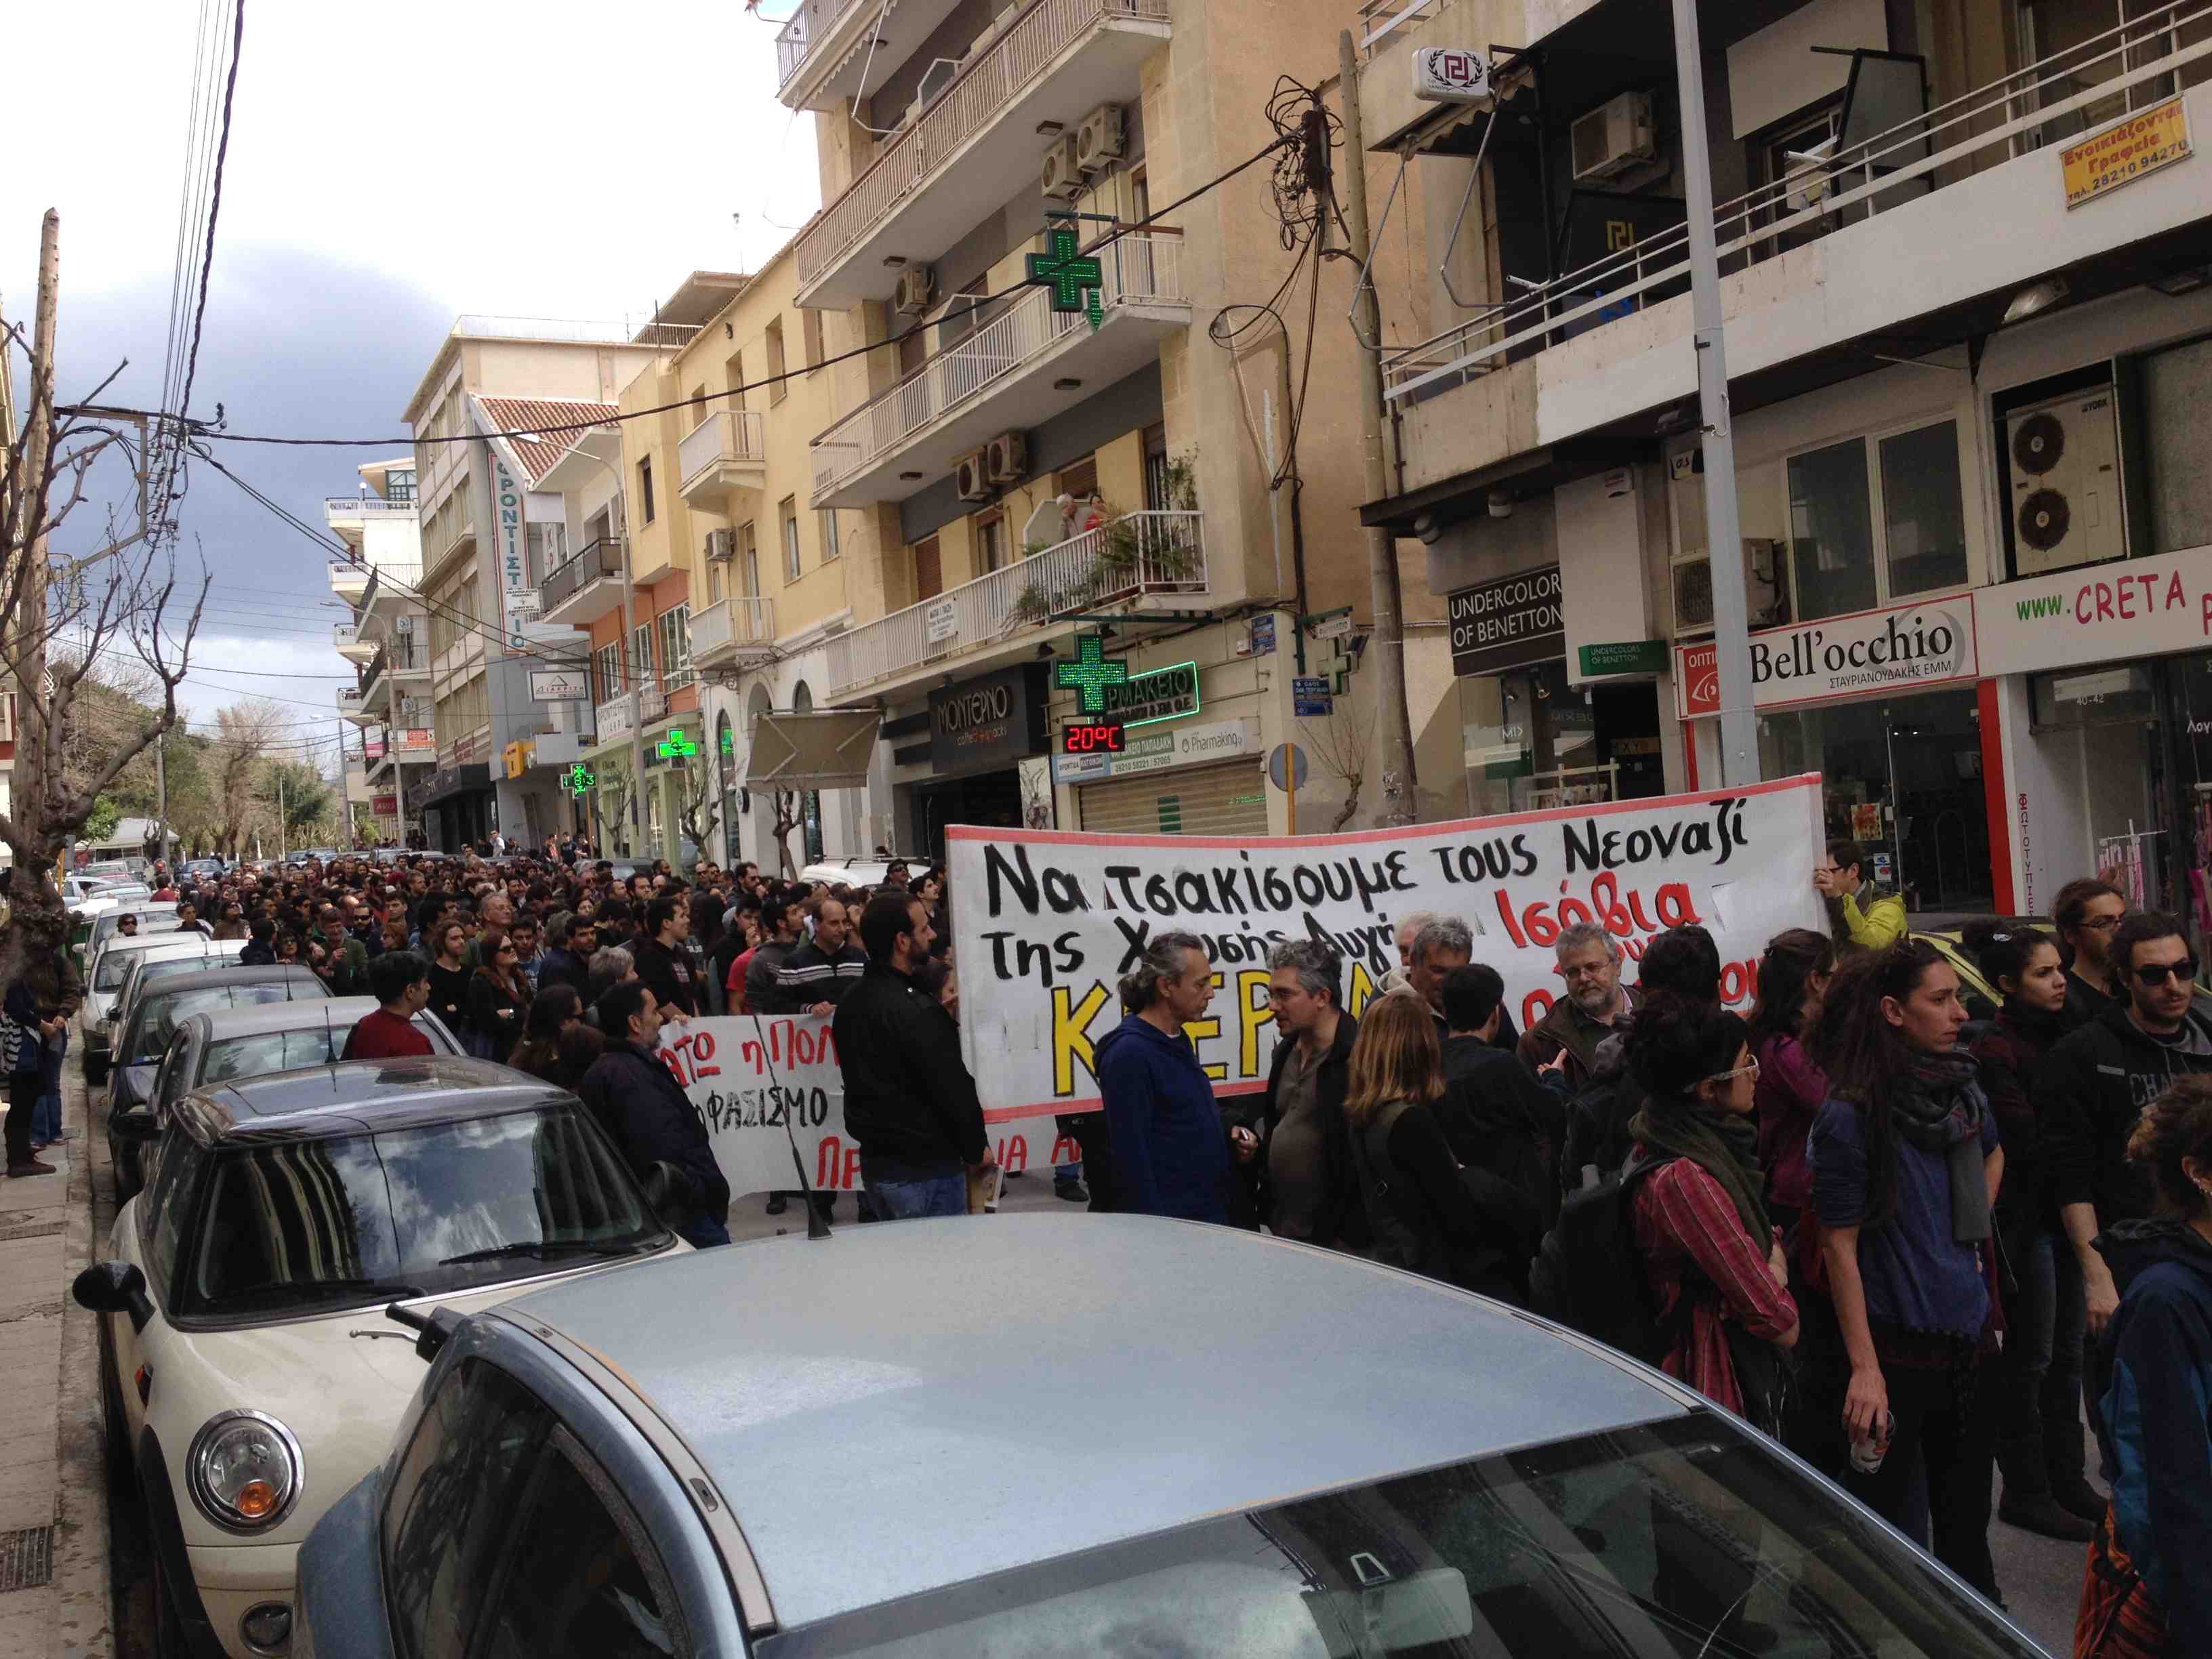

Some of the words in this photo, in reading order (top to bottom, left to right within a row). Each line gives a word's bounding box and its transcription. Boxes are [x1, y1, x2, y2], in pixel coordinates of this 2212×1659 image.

[2088, 133, 2160, 174] Γραφεία
[2092, 162, 2136, 190] 28210
[2140, 139, 2188, 167] 94270
[1454, 625, 1474, 647] OF
[1478, 602, 1564, 643] BENETTON
[1107, 670, 1187, 710] ΡΜΑΚΕΙΟ
[1829, 666, 1921, 689] ΣΤΑΥΡΙΑΝΟΥΔΑΚΗΣ
[1924, 660, 1952, 676] ΕΜΜ
[2076, 694, 2104, 705] 40-42
[984, 843, 1090, 918] Να
[1431, 833, 1538, 884] τους
[1562, 798, 1748, 874] Νεοναζί
[981, 930, 1085, 988] της
[741, 1040, 763, 1074] η
